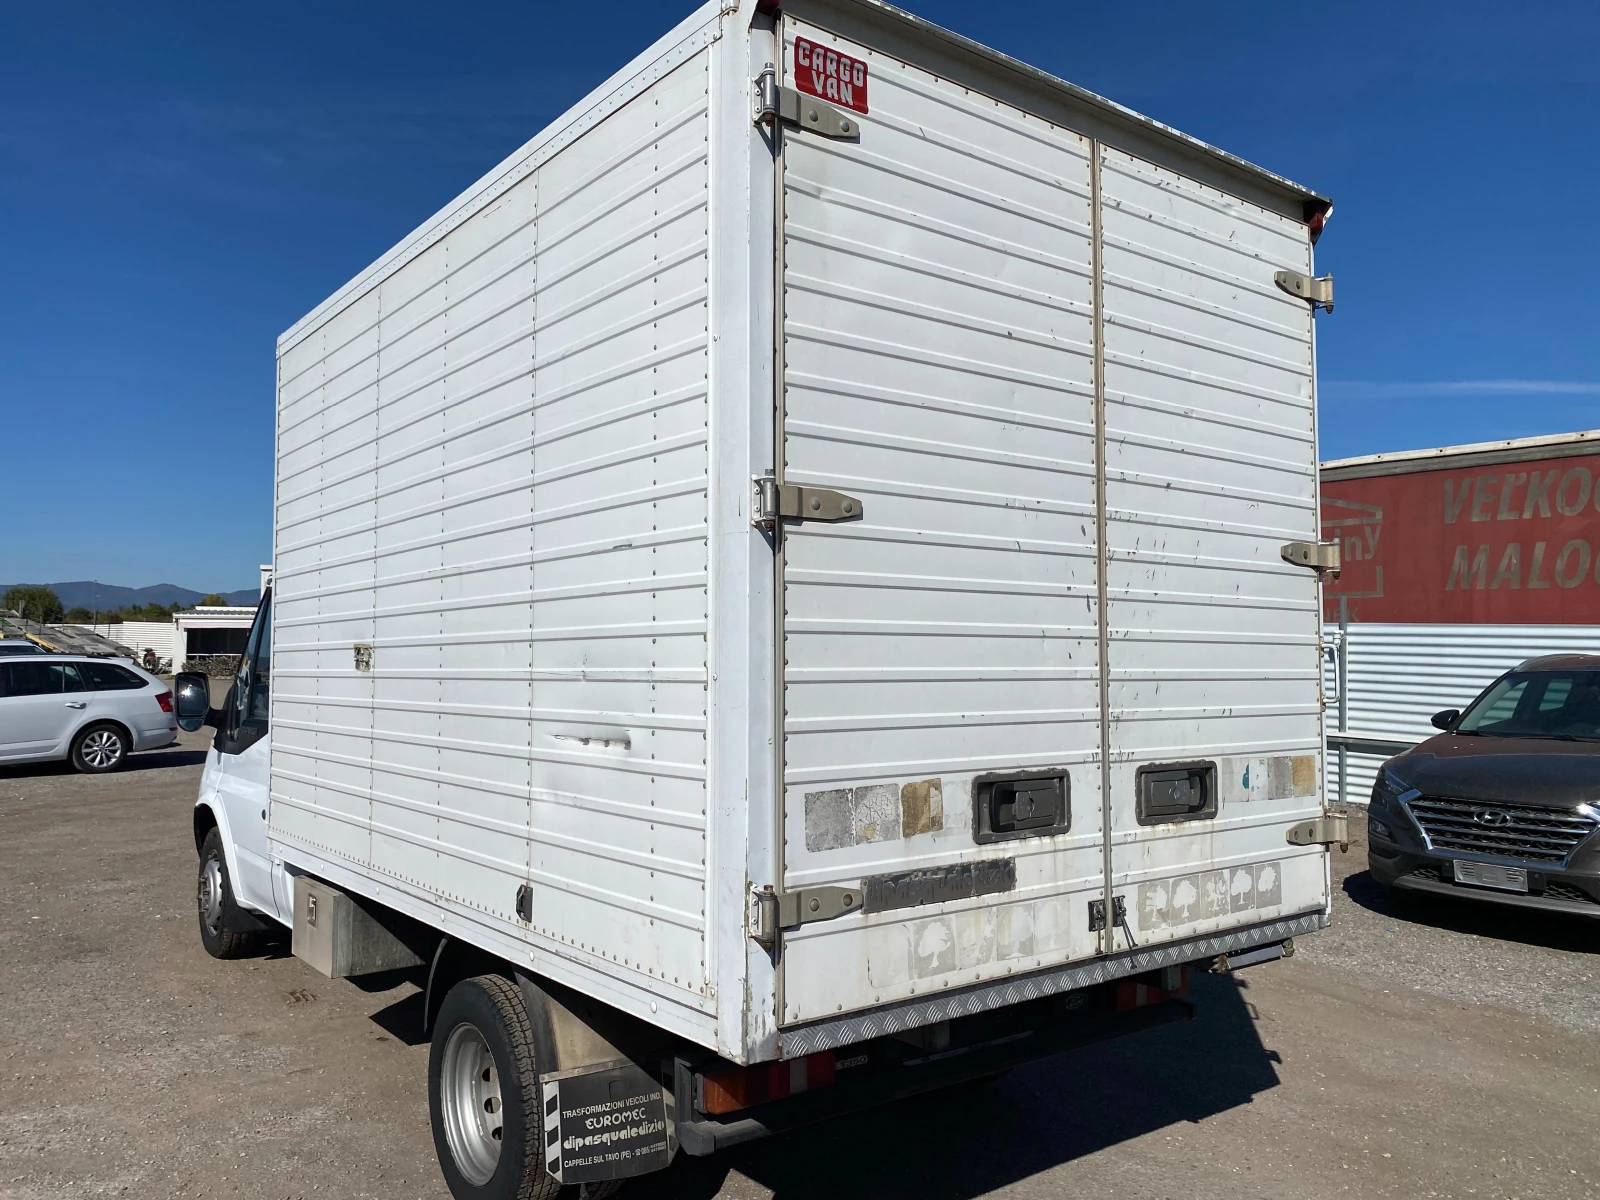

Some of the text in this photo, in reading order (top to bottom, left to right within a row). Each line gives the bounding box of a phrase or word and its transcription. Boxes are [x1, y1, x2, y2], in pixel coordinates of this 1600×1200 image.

[798, 41, 865, 88] CARGO
[811, 69, 854, 106] VAN
[1443, 466, 1600, 524] VEĽKO
[1445, 538, 1600, 591] MALO
[1067, 993, 1088, 1009] Ford
[840, 1056, 866, 1067] T350
[562, 1092, 662, 1119] TRASFORMAZIONI VEICOLI IND.
[585, 1107, 647, 1130] EUROMEC
[564, 1156, 593, 1168] CAPPELLE
[593, 1154, 605, 1164] SUL
[605, 1152, 620, 1161] TAVO
[620, 1150, 632, 1161] (PE)
